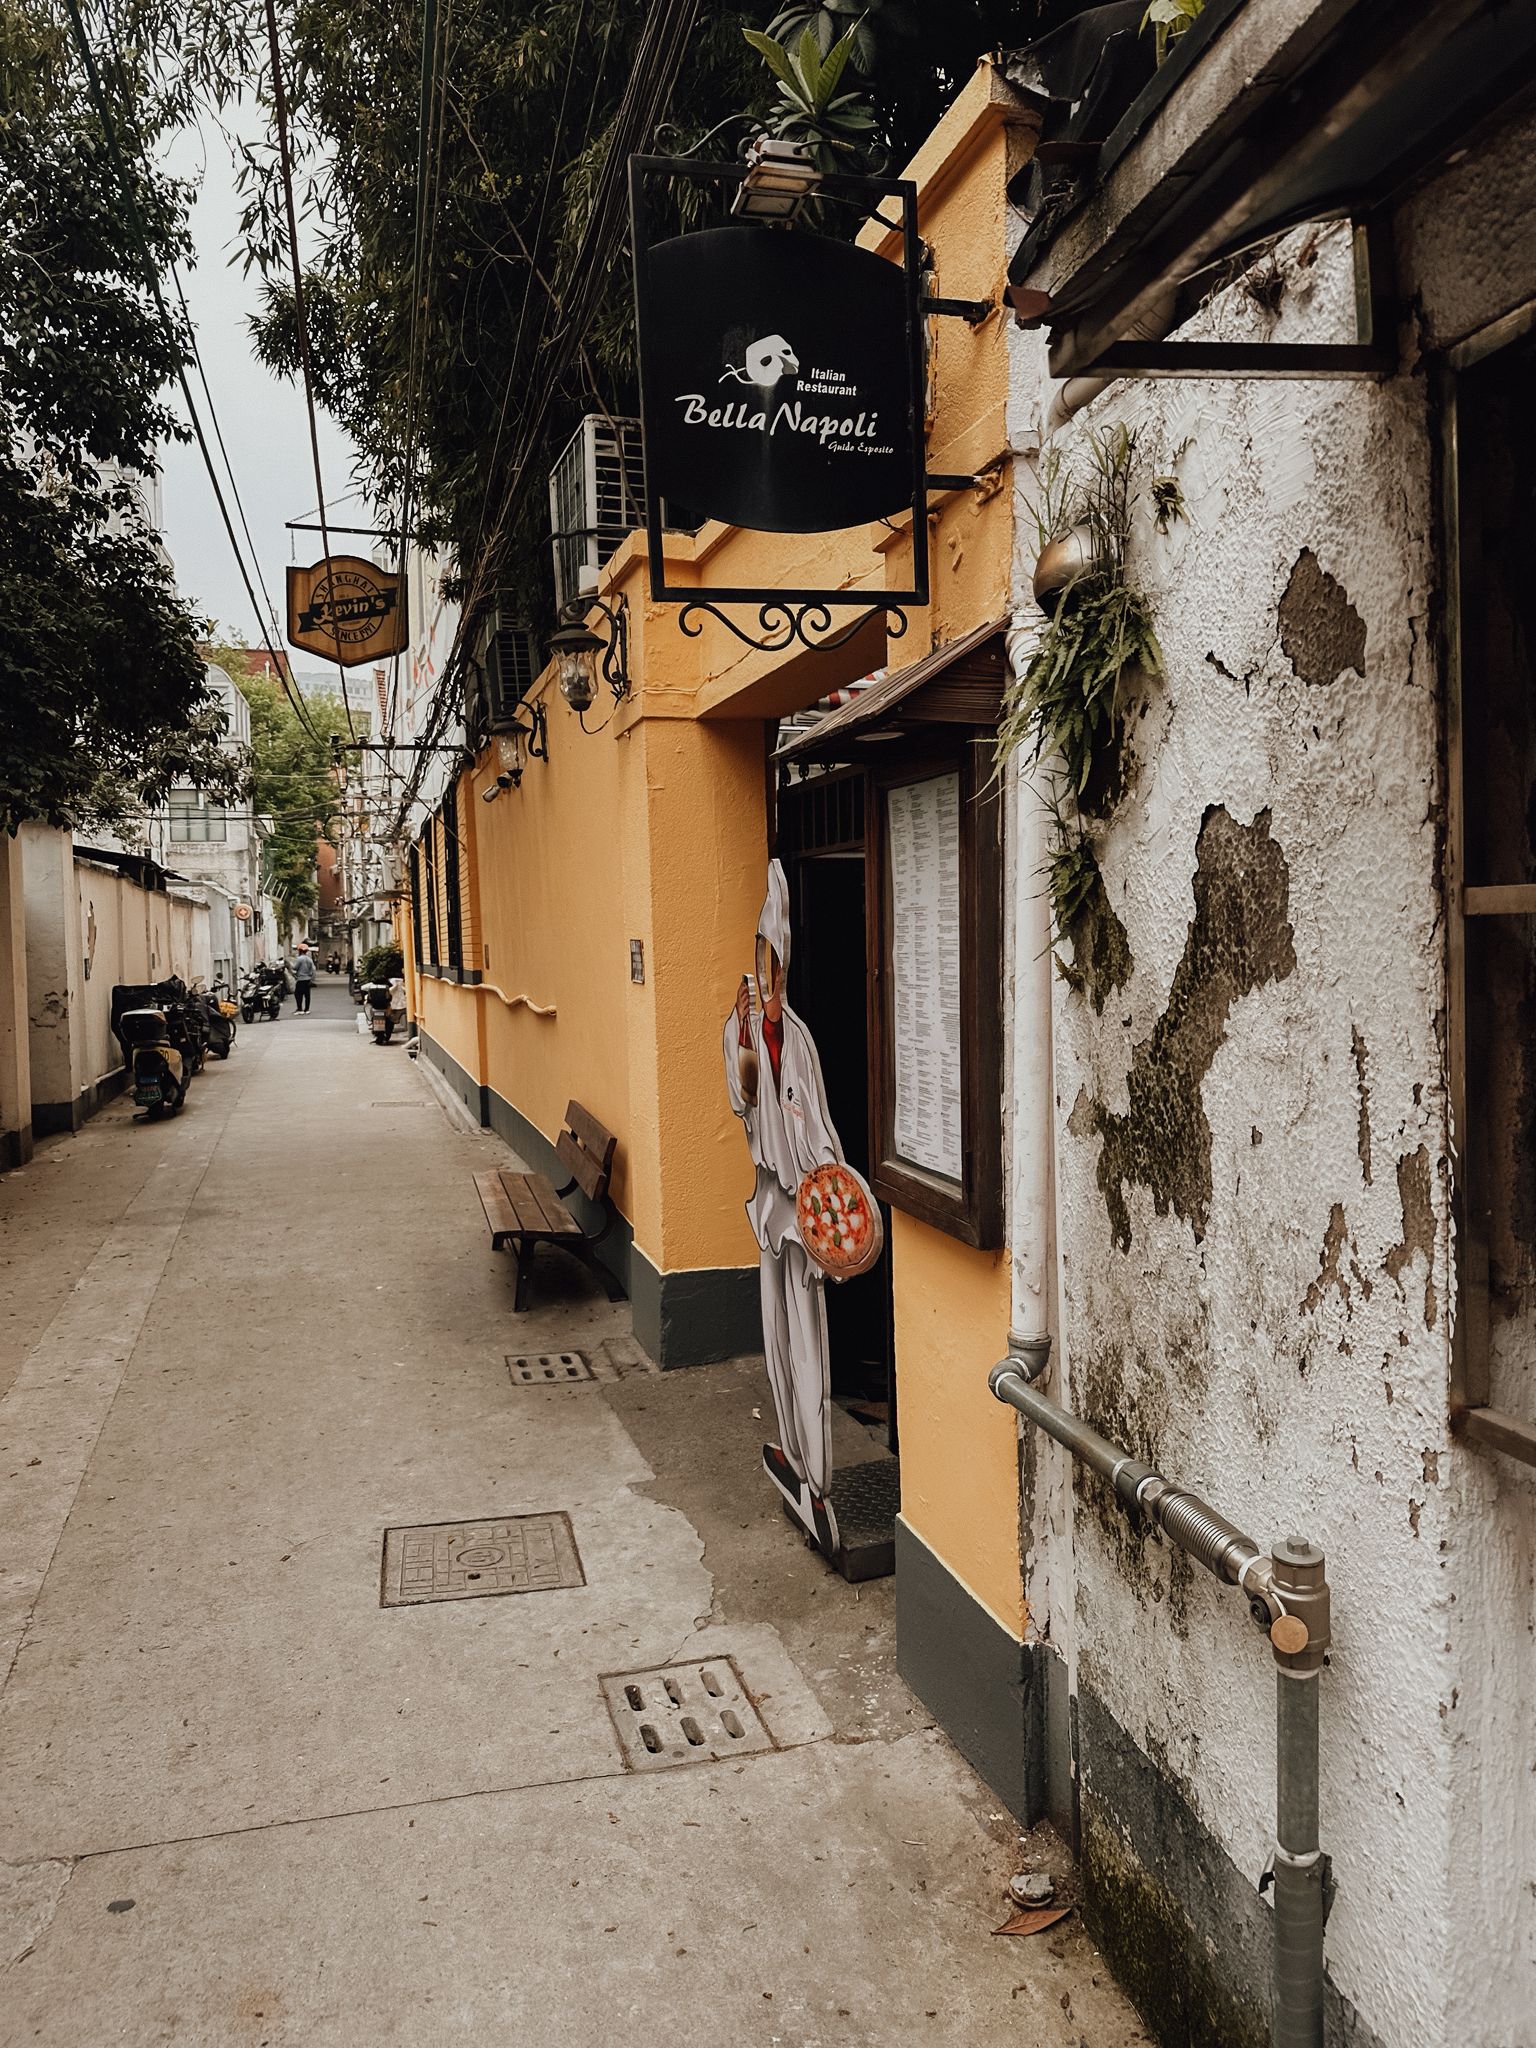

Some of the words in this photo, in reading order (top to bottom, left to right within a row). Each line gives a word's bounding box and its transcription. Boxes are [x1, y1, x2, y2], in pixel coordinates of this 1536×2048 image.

[811, 367, 846, 382] Italian
[796, 380, 857, 397] Restaurant
[674, 394, 766, 432] Bella
[769, 401, 878, 445] Napoli
[828, 441, 855, 453] Guido
[857, 442, 894, 455] Esposito
[330, 627, 359, 641] SNCE
